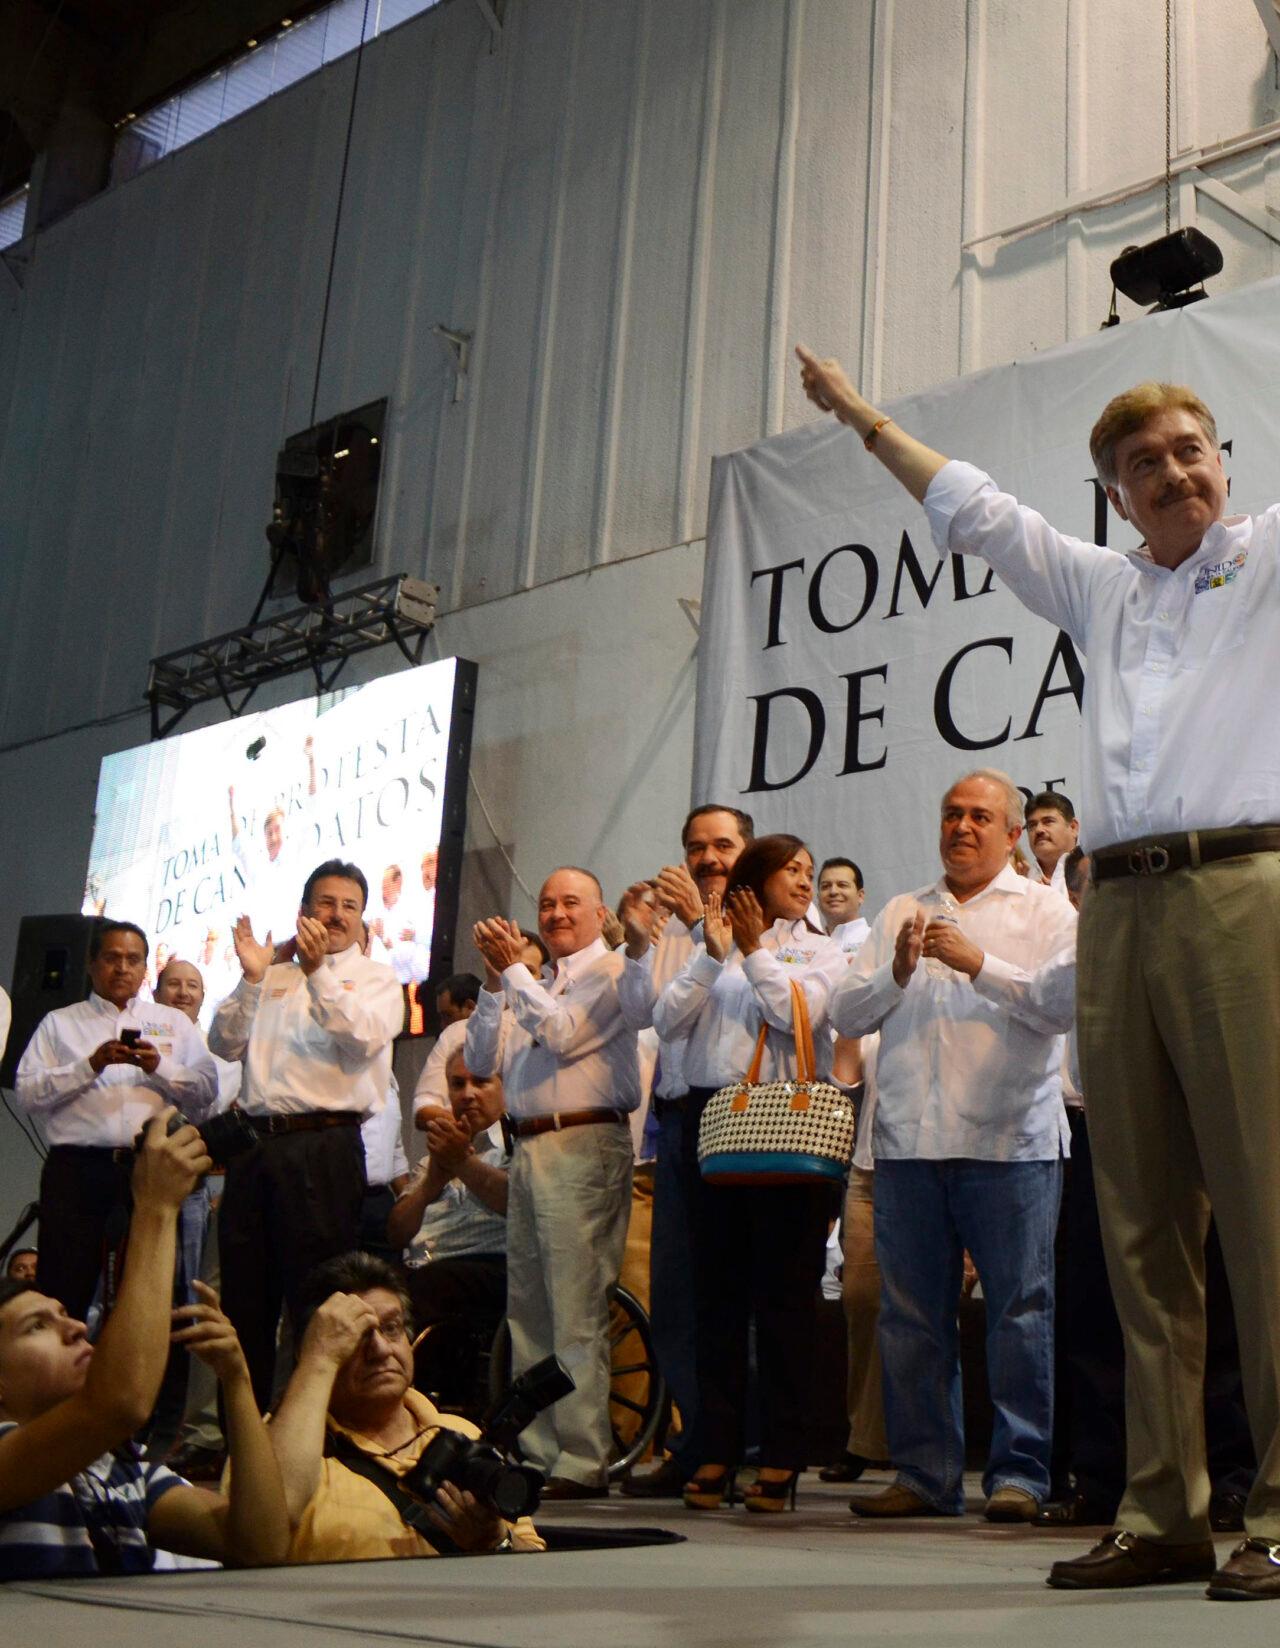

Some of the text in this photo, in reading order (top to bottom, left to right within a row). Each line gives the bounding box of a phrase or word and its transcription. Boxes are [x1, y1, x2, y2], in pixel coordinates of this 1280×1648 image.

[751, 529, 997, 650] TOM
[739, 663, 888, 794] DE
[156, 888, 187, 934] DE
